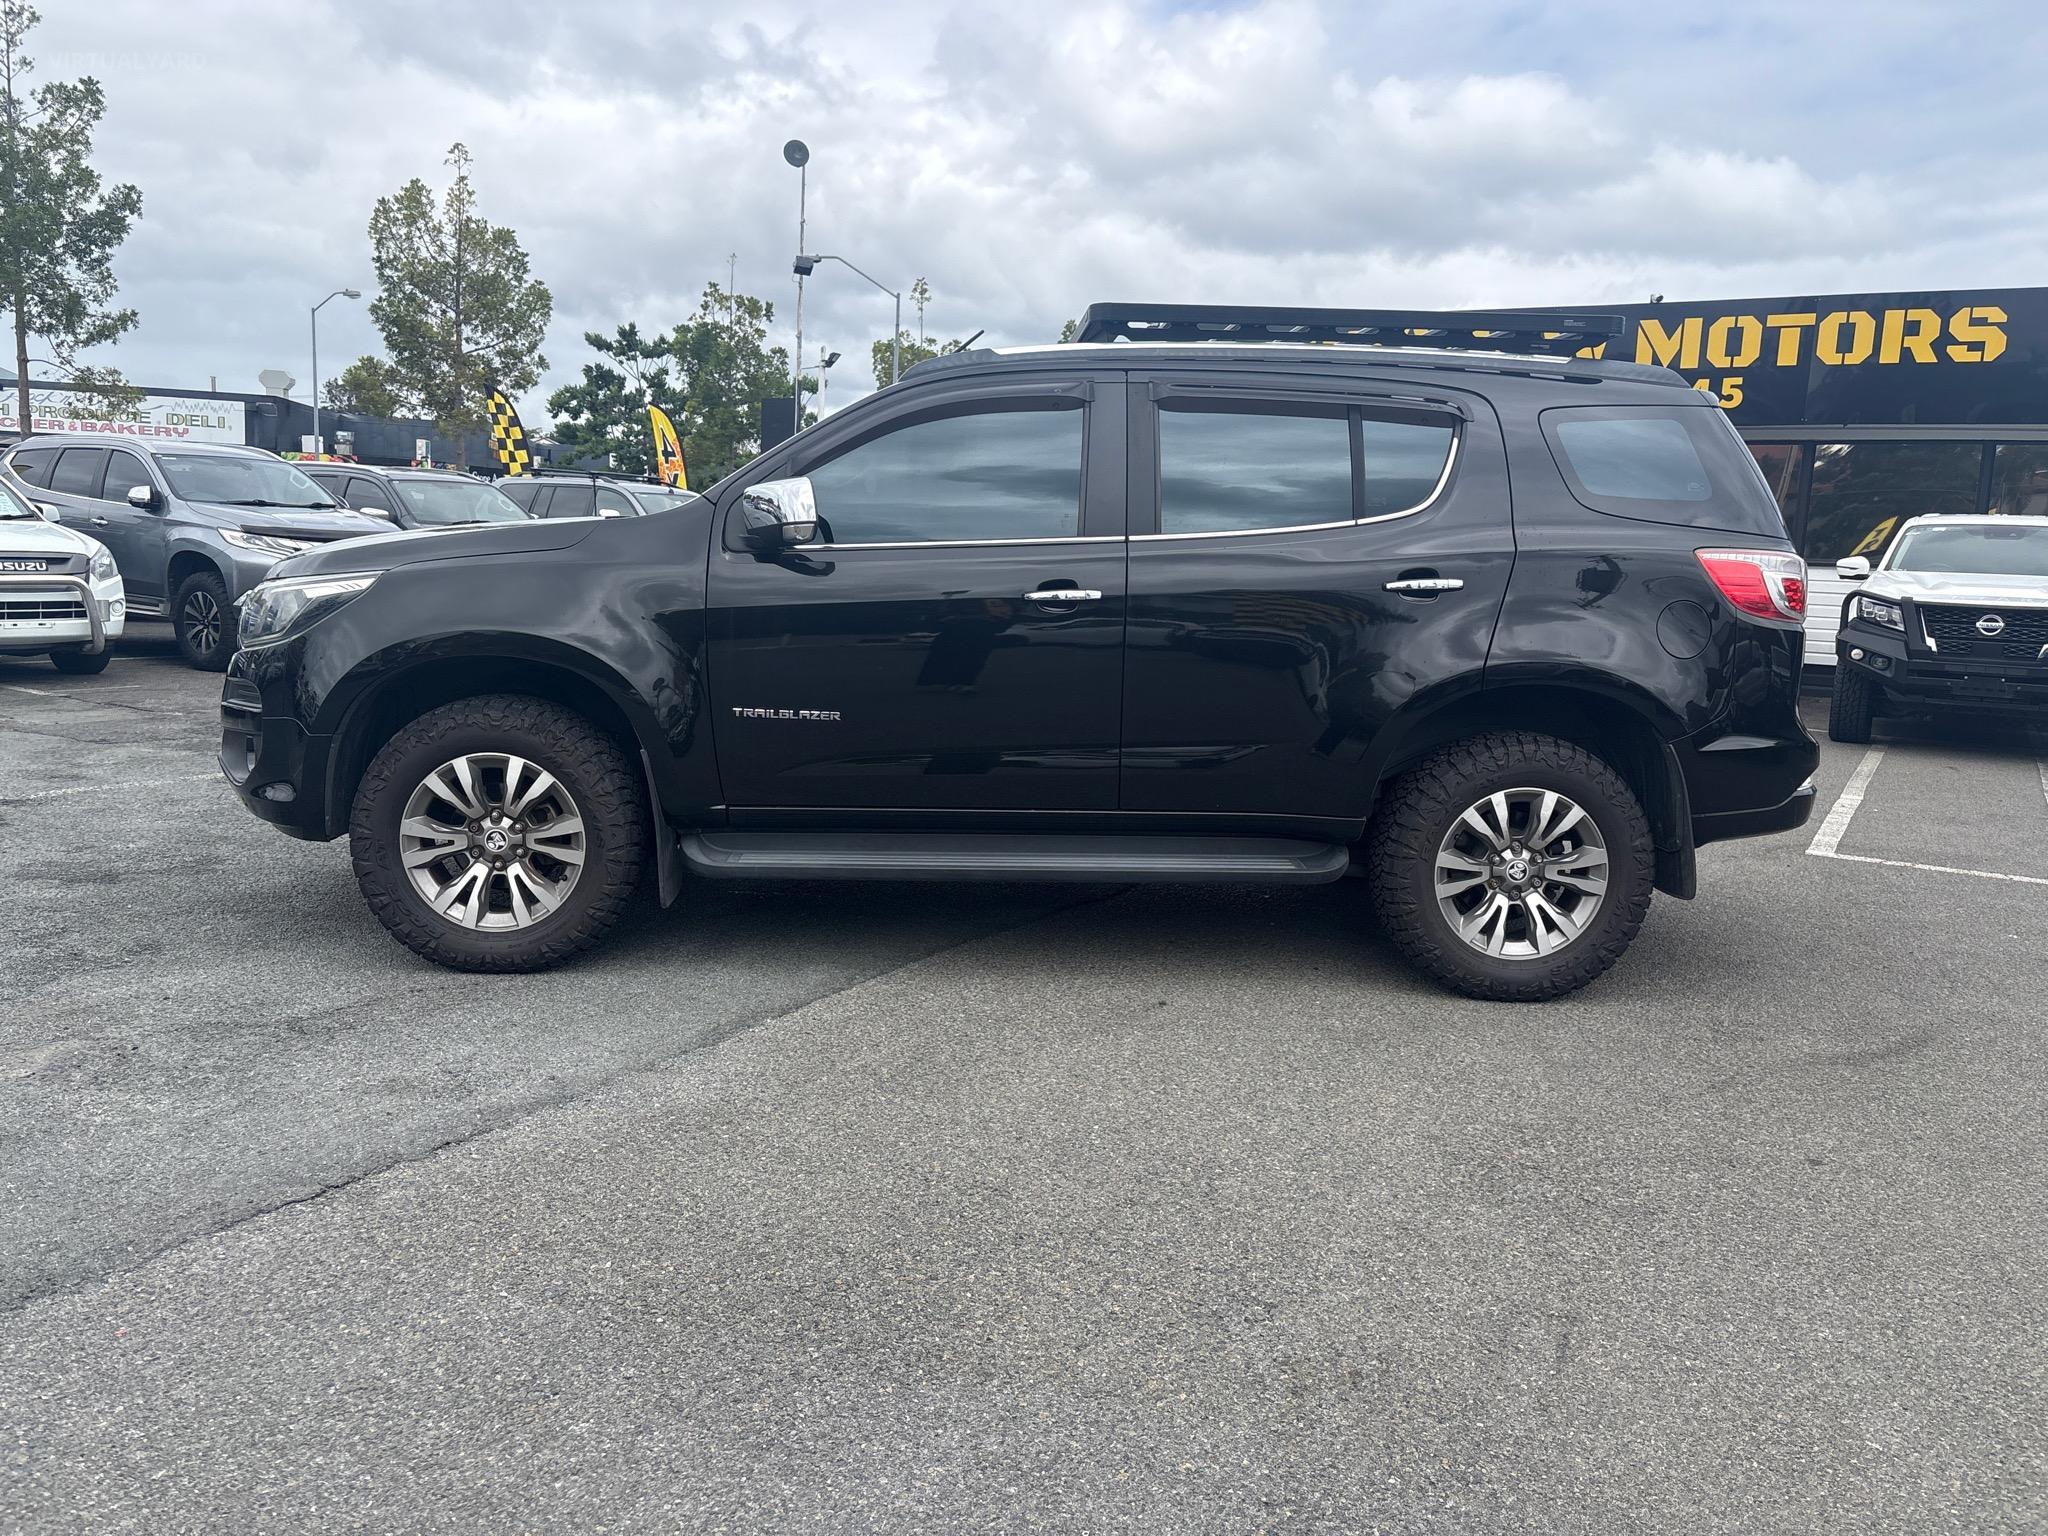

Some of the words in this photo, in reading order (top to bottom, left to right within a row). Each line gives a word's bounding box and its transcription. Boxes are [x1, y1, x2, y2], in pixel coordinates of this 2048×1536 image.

[1635, 306, 2008, 369] MOTORS
[166, 413, 226, 429] DELI
[68, 421, 78, 432] &
[81, 421, 190, 438] BAKERY
[732, 707, 841, 721] TRAILBLAZER
